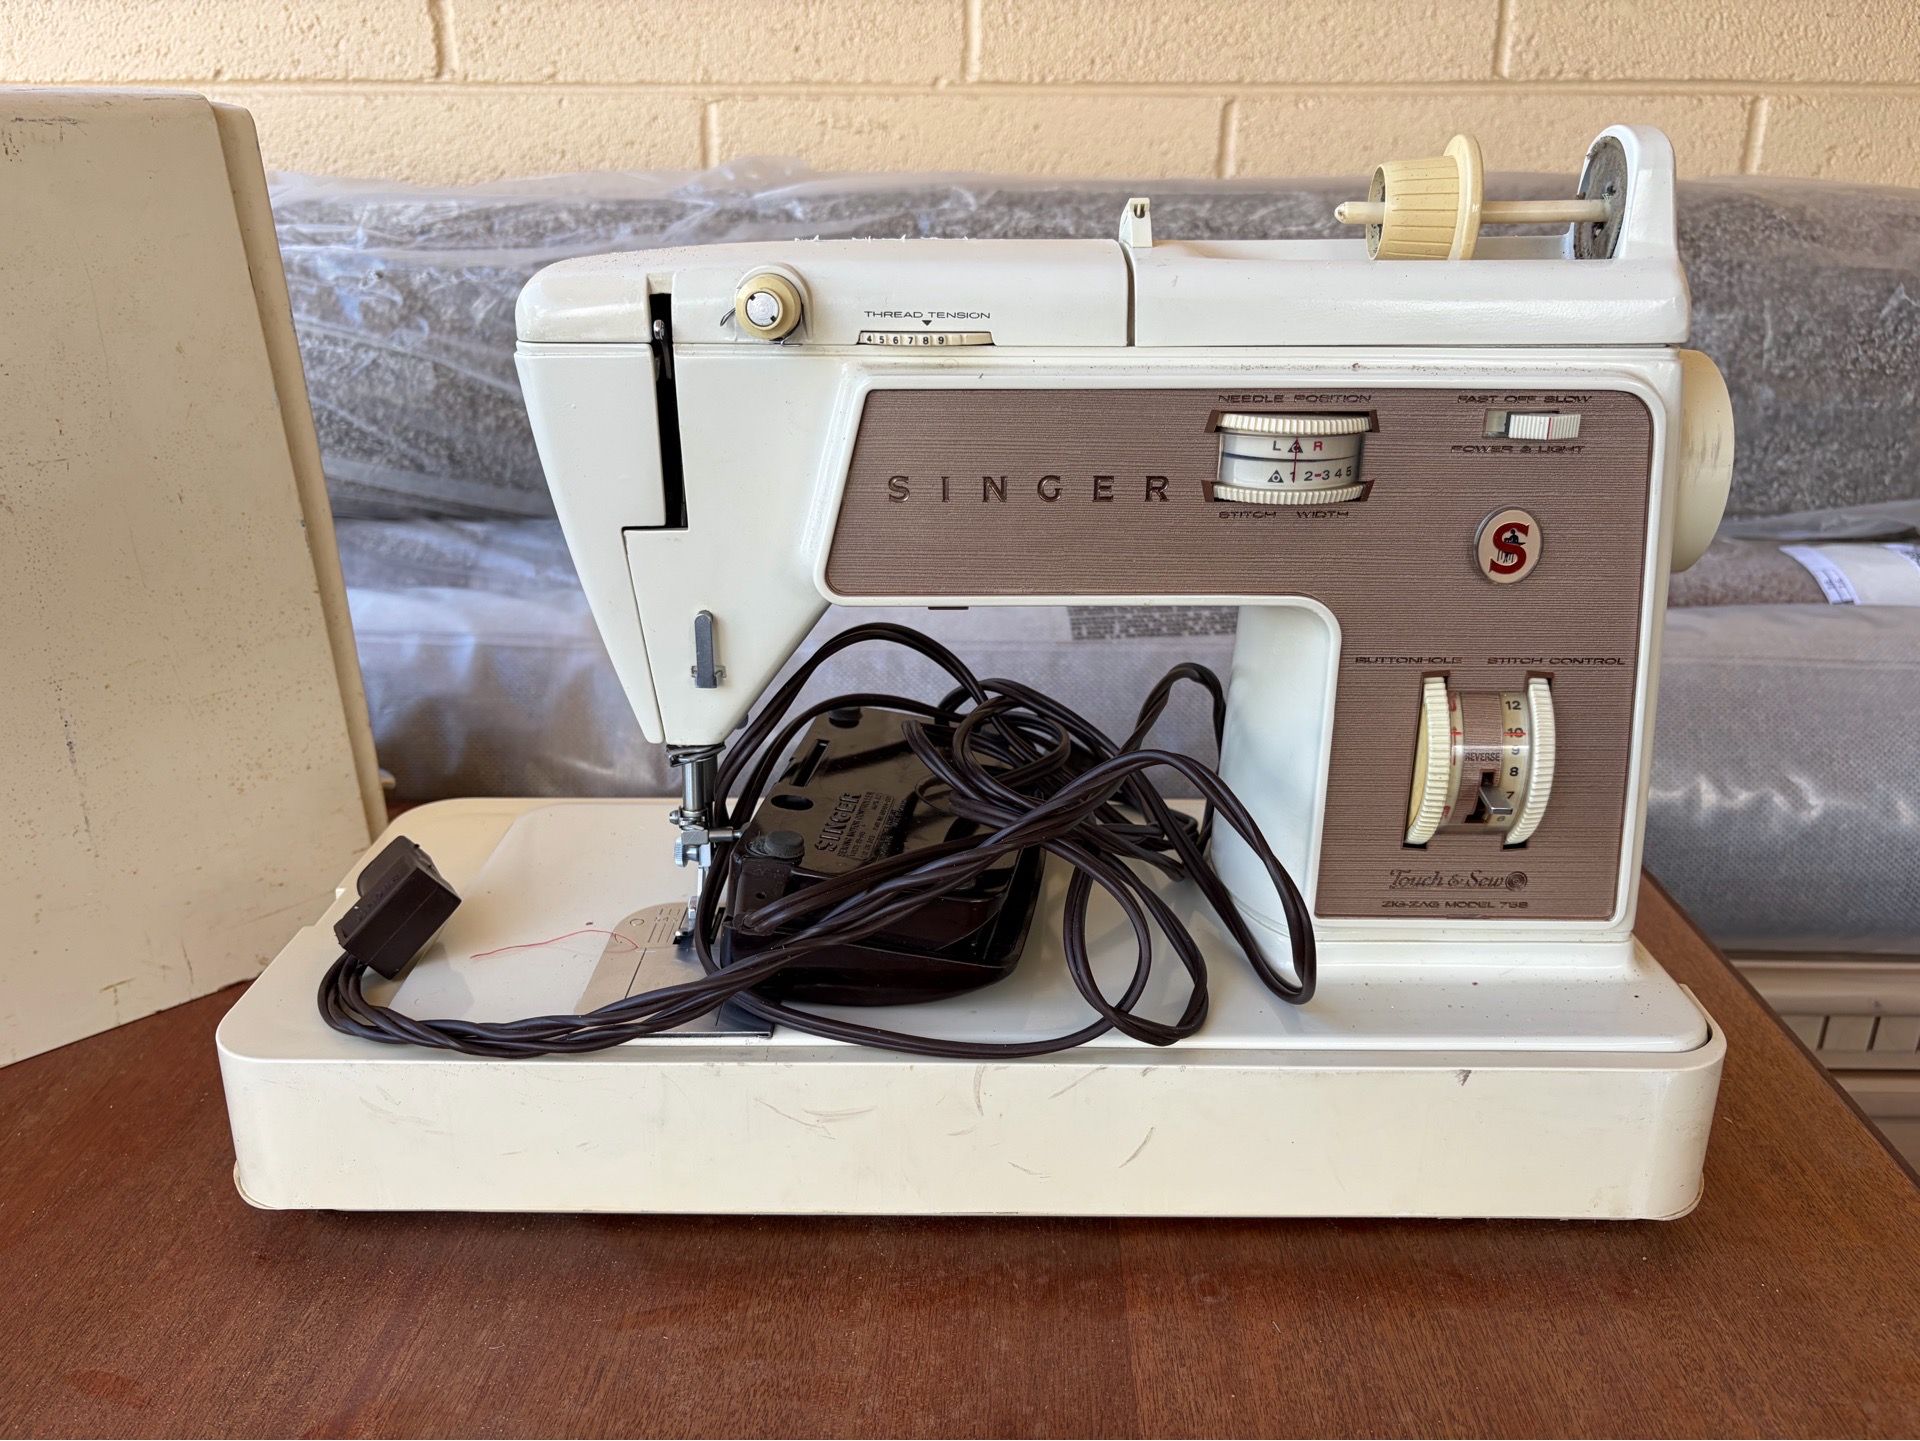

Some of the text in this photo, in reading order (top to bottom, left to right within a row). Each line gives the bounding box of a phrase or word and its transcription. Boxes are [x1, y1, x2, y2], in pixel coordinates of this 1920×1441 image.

[864, 310, 991, 319] THREAD TENSION
[866, 335, 944, 345] 4 5 6 7 8 9
[1218, 394, 1372, 403] NEEDLE POSITION
[1457, 395, 1593, 404] FAST OFF SLOW
[1272, 440, 1323, 451] L R
[1451, 445, 1513, 453] POWER
[1537, 445, 1585, 454] LIGHT
[1334, 470, 1342, 478] 4
[1346, 466, 1352, 477] 5
[888, 474, 1170, 503] SINGER
[1218, 511, 1350, 520] STITCH WIDTH
[1355, 656, 1463, 665] BUTTONHOLE
[1487, 657, 1626, 666] STITCH CONTROL
[1505, 701, 1521, 710] 12
[1507, 727, 1524, 738] 10
[1464, 752, 1501, 762] REVERSE
[1509, 766, 1519, 777] 8
[1506, 791, 1515, 799] 7
[815, 792, 862, 852] SINGER
[1389, 869, 1444, 889] Touch
[1466, 869, 1504, 888] Sew
[1445, 901, 1495, 909] MODEL
